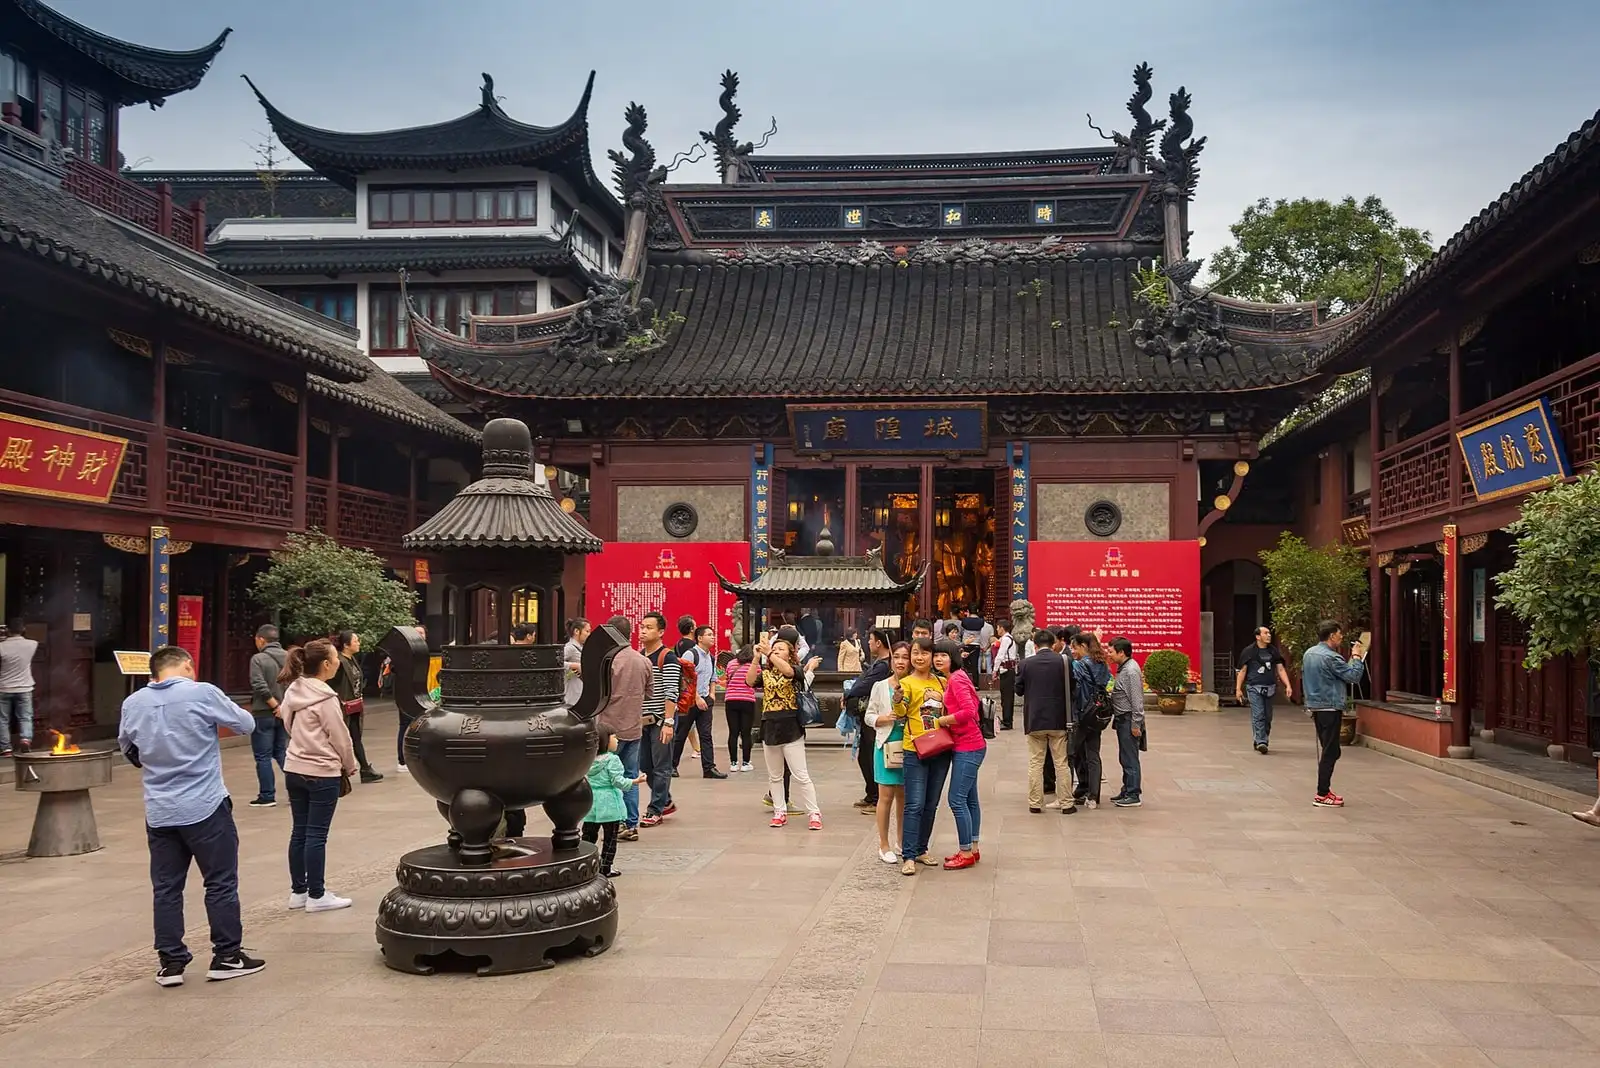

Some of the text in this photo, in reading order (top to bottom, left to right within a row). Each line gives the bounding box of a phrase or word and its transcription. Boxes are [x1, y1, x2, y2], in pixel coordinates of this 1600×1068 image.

[822, 416, 959, 441] 城隍廟
[1479, 423, 1548, 481] 慈航殿
[0, 436, 109, 485] 財神殿
